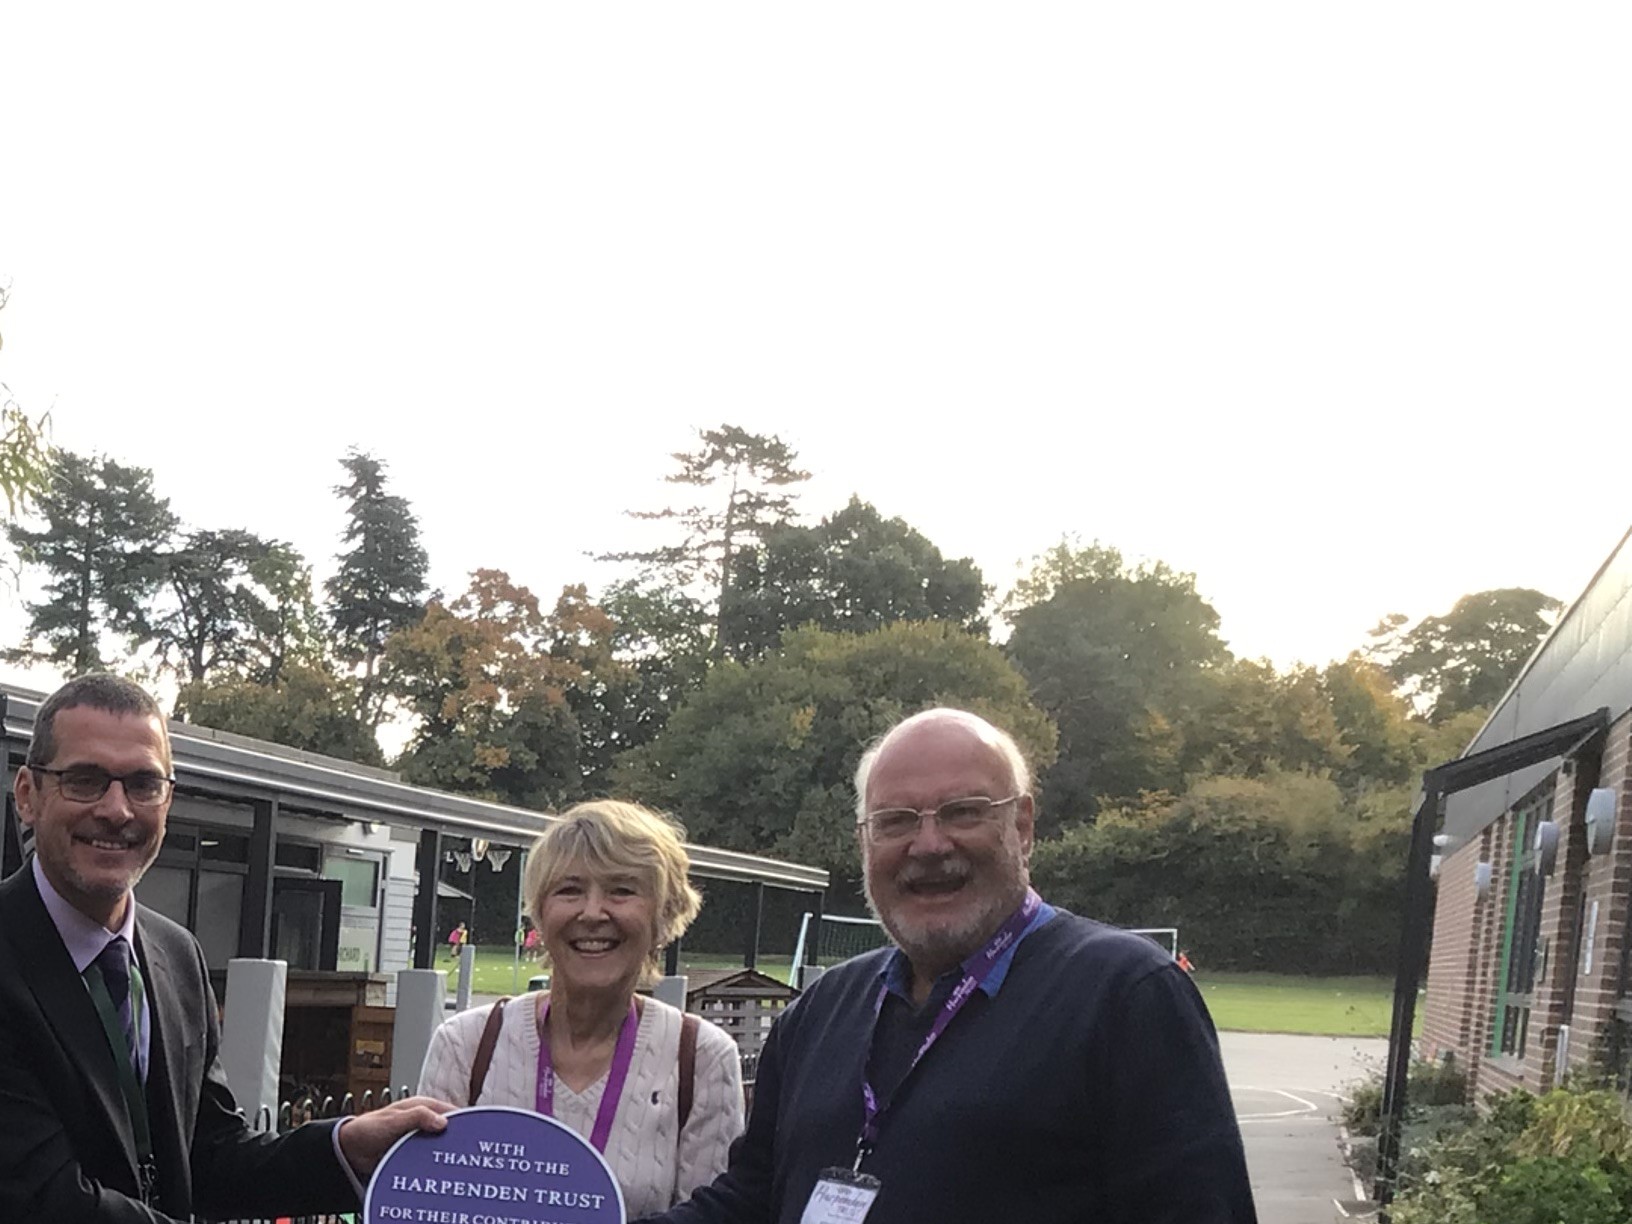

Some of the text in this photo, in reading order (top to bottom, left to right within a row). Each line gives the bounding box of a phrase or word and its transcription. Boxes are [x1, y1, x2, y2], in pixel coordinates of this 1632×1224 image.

[478, 1141, 525, 1156] WITH
[432, 1151, 570, 1175] THANKS TO THE
[392, 1176, 605, 1209] HARPENDEN TRUST
[379, 1206, 413, 1220] FOR
[416, 1209, 470, 1224] THEIR
